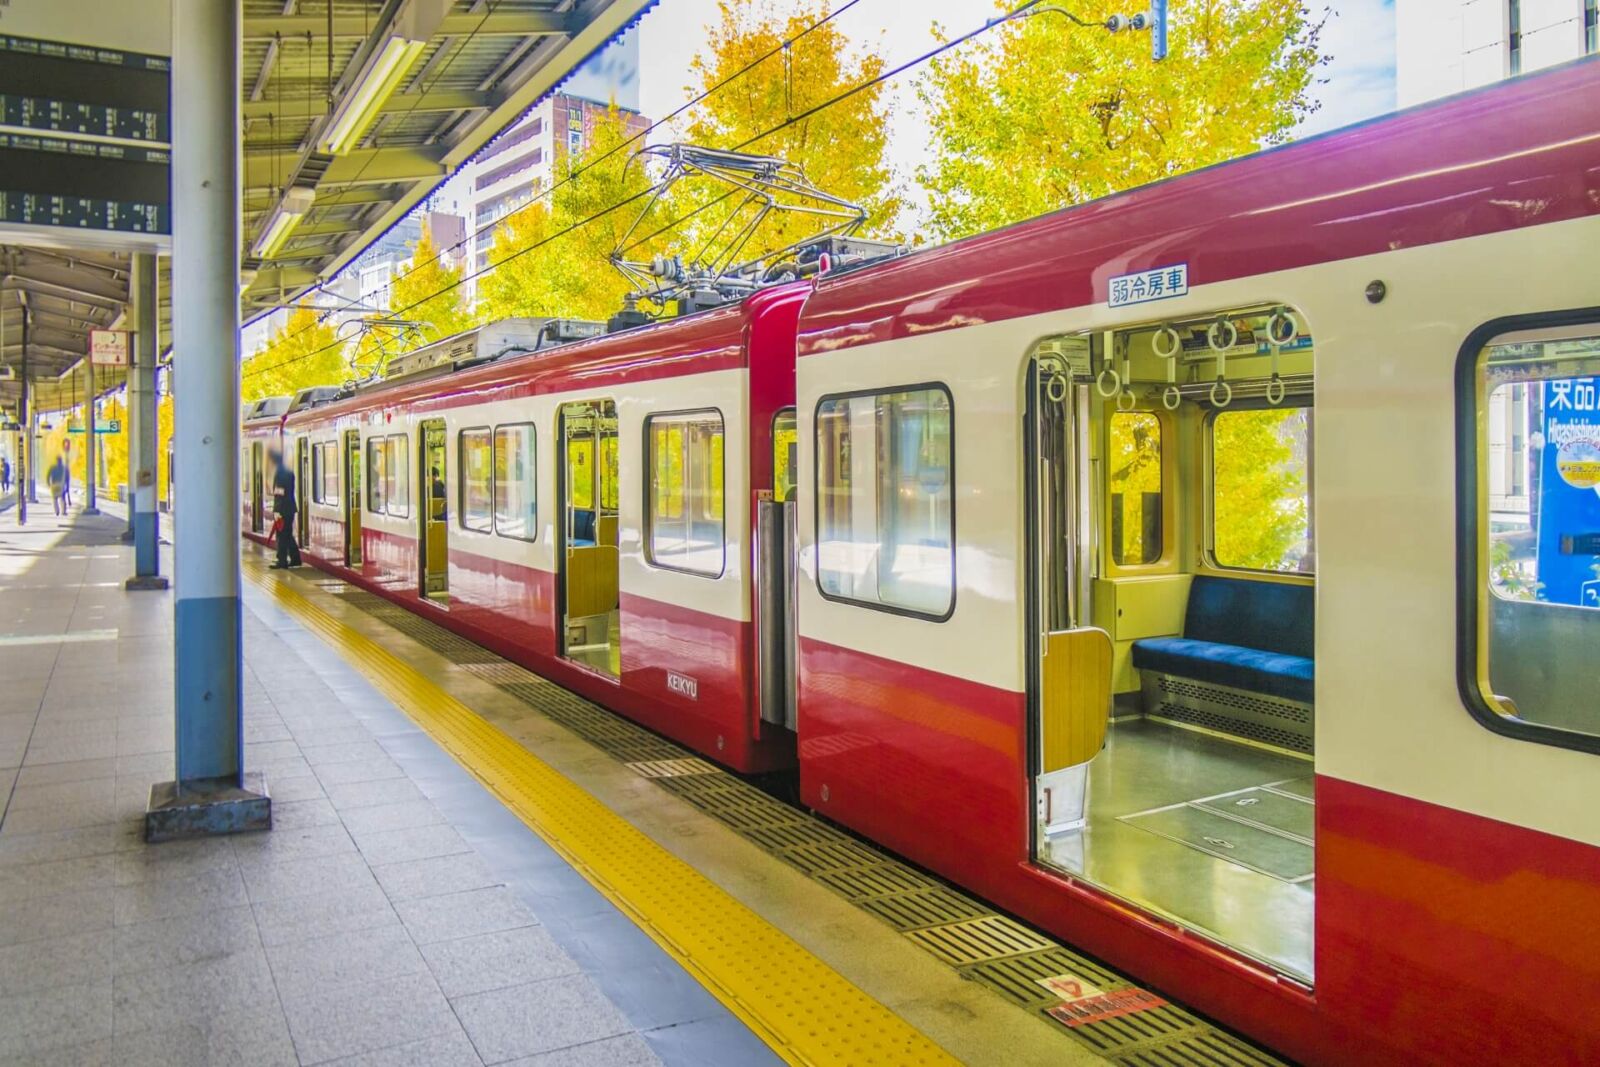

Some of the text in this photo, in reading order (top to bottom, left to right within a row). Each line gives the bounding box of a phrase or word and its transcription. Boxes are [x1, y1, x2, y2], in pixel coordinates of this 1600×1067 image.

[1112, 268, 1184, 302] 弱冷房車
[110, 422, 118, 432] 3
[667, 672, 697, 697] KEIKYU
